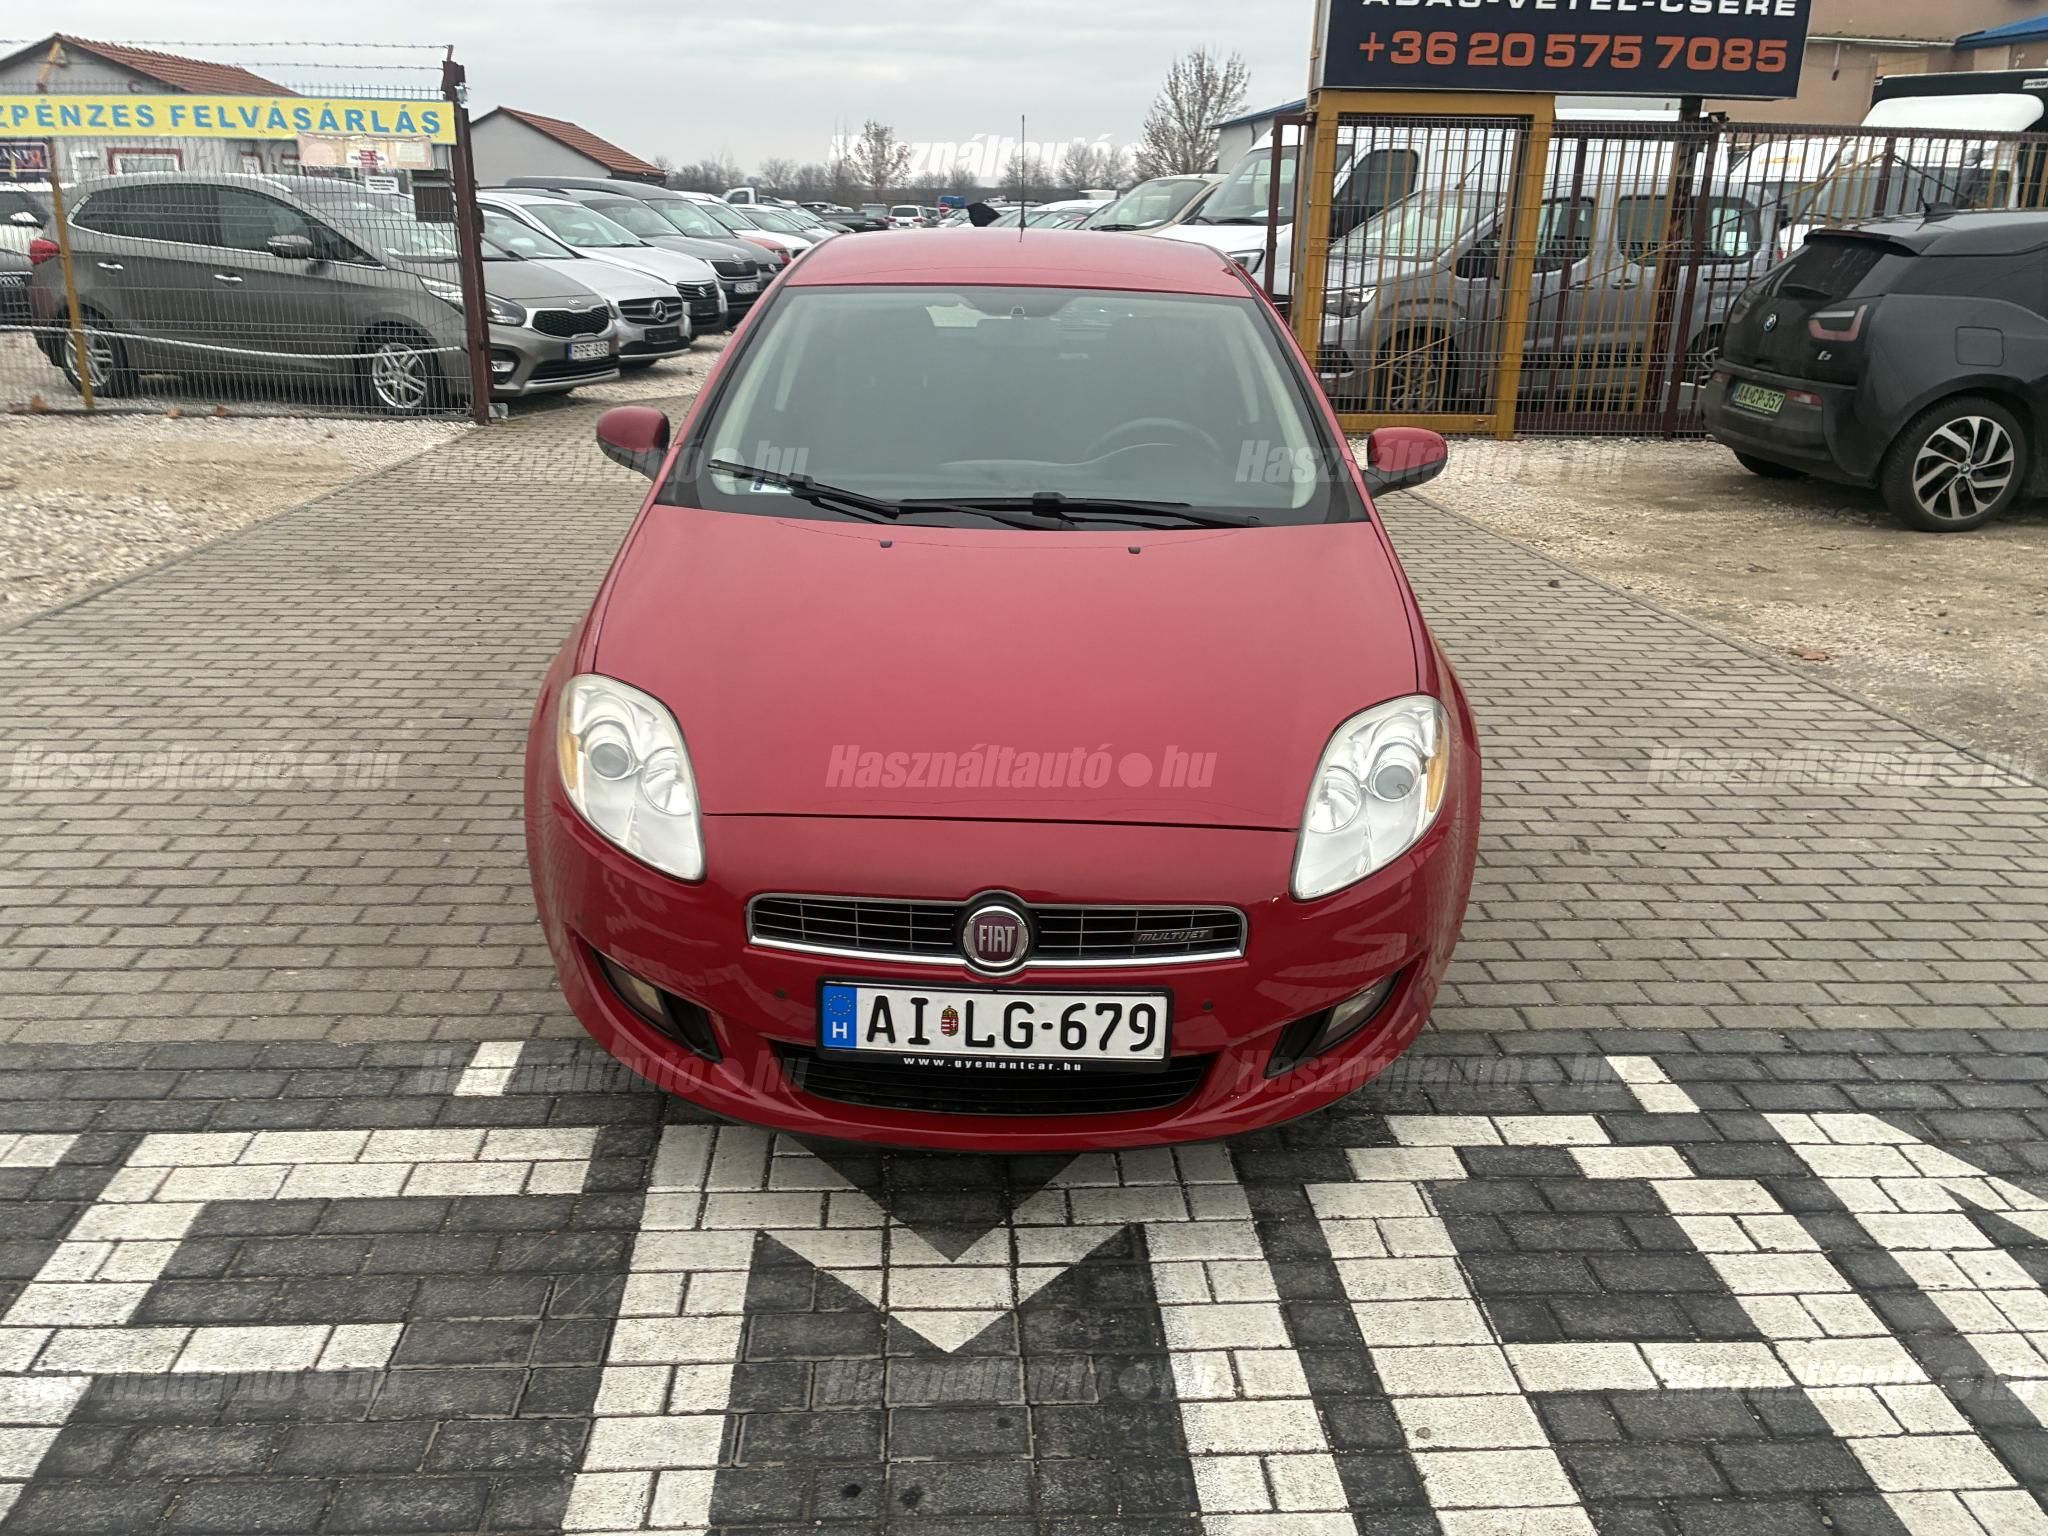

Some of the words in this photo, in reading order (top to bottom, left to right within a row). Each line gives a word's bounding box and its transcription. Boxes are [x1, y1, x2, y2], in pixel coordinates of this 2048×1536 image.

[1359, 31, 1457, 66] +36
[1467, 32, 1535, 67] 20
[1543, 34, 1643, 69] 575
[1654, 37, 1787, 73] 7085
[170, 101, 441, 134] FELVÁSÁRLÁS
[978, 924, 1016, 953] FIAT
[1136, 930, 1209, 942] MULTIJET
[831, 1021, 848, 1040] H
[964, 999, 1157, 1052] LG-679
[902, 1056, 1083, 1072] www.gyemantcar.hu
